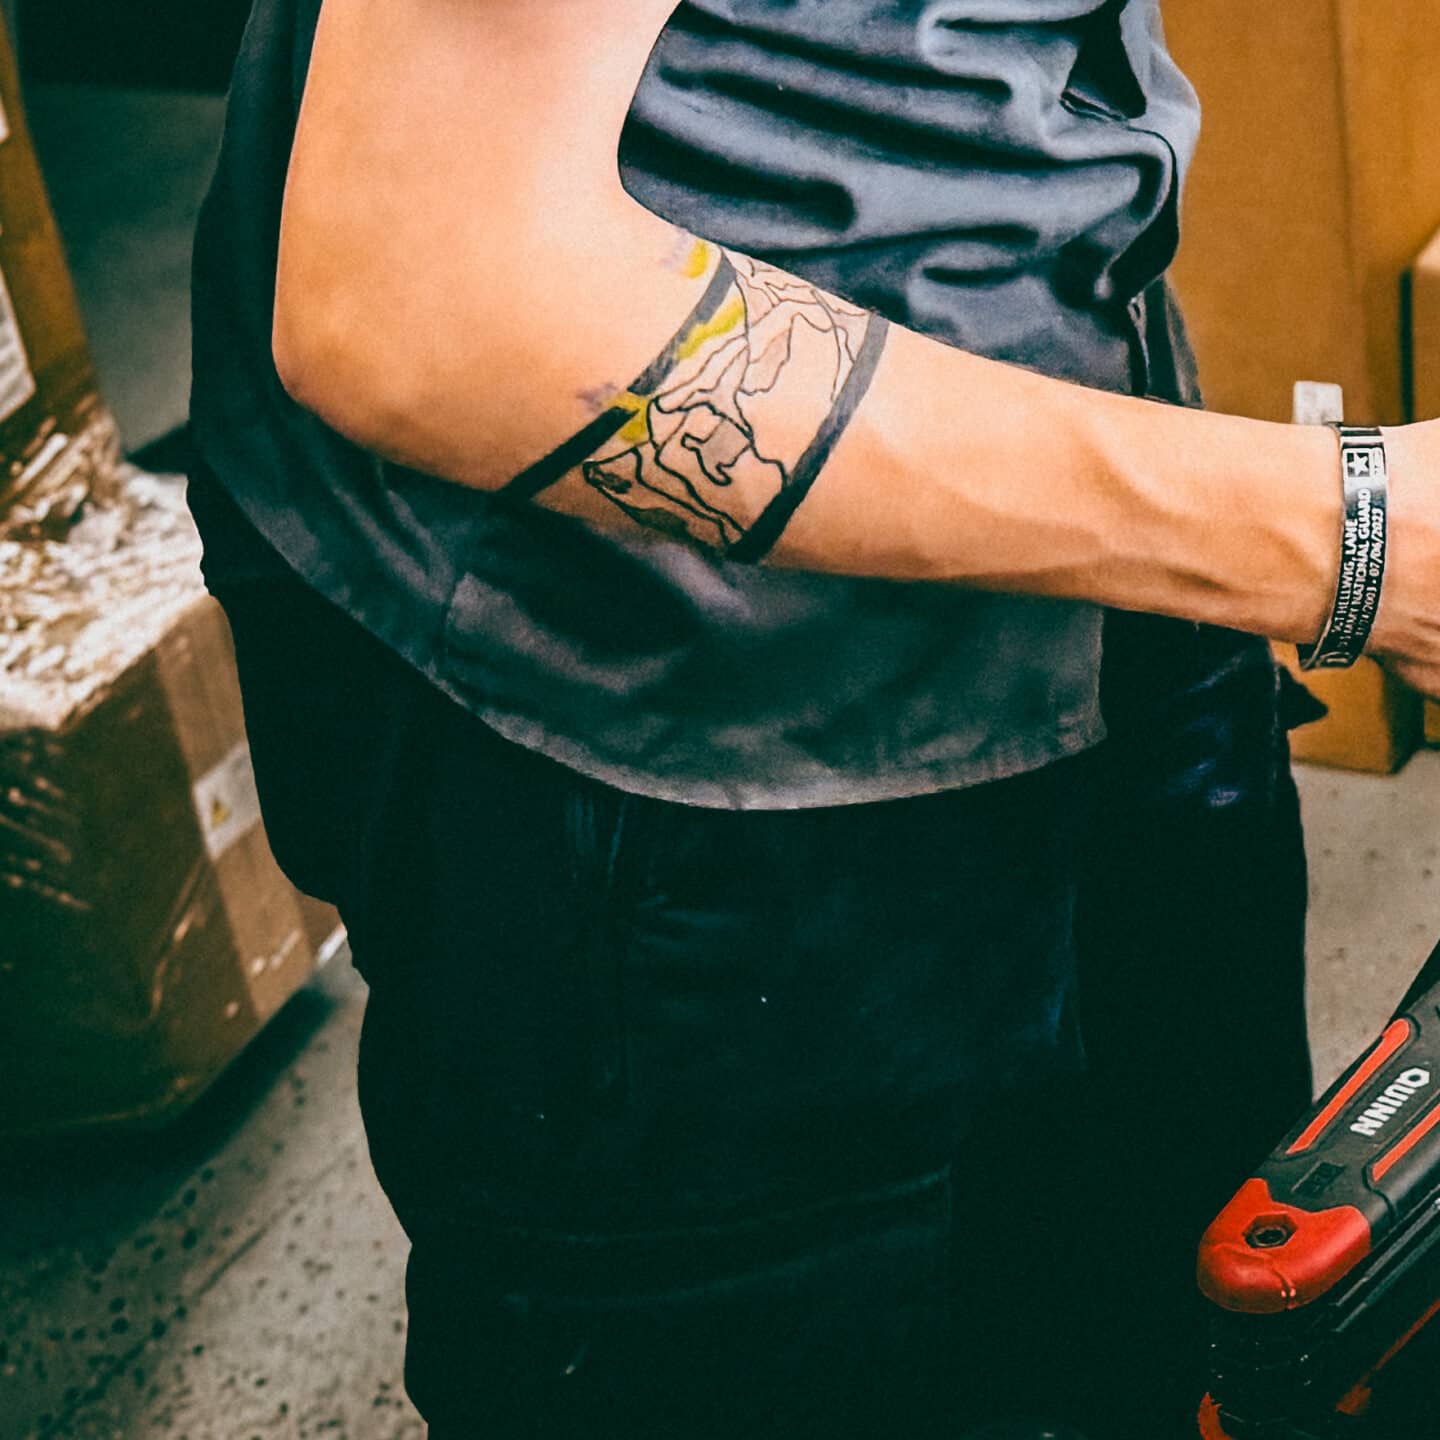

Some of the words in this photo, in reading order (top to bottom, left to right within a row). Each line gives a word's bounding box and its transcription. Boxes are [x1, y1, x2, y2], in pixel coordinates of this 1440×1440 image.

[1344, 518, 1358, 555] LANE
[1357, 488, 1371, 539] GUARD
[1350, 540, 1370, 605] NATIONAL
[1349, 1066, 1430, 1137] QUINN
